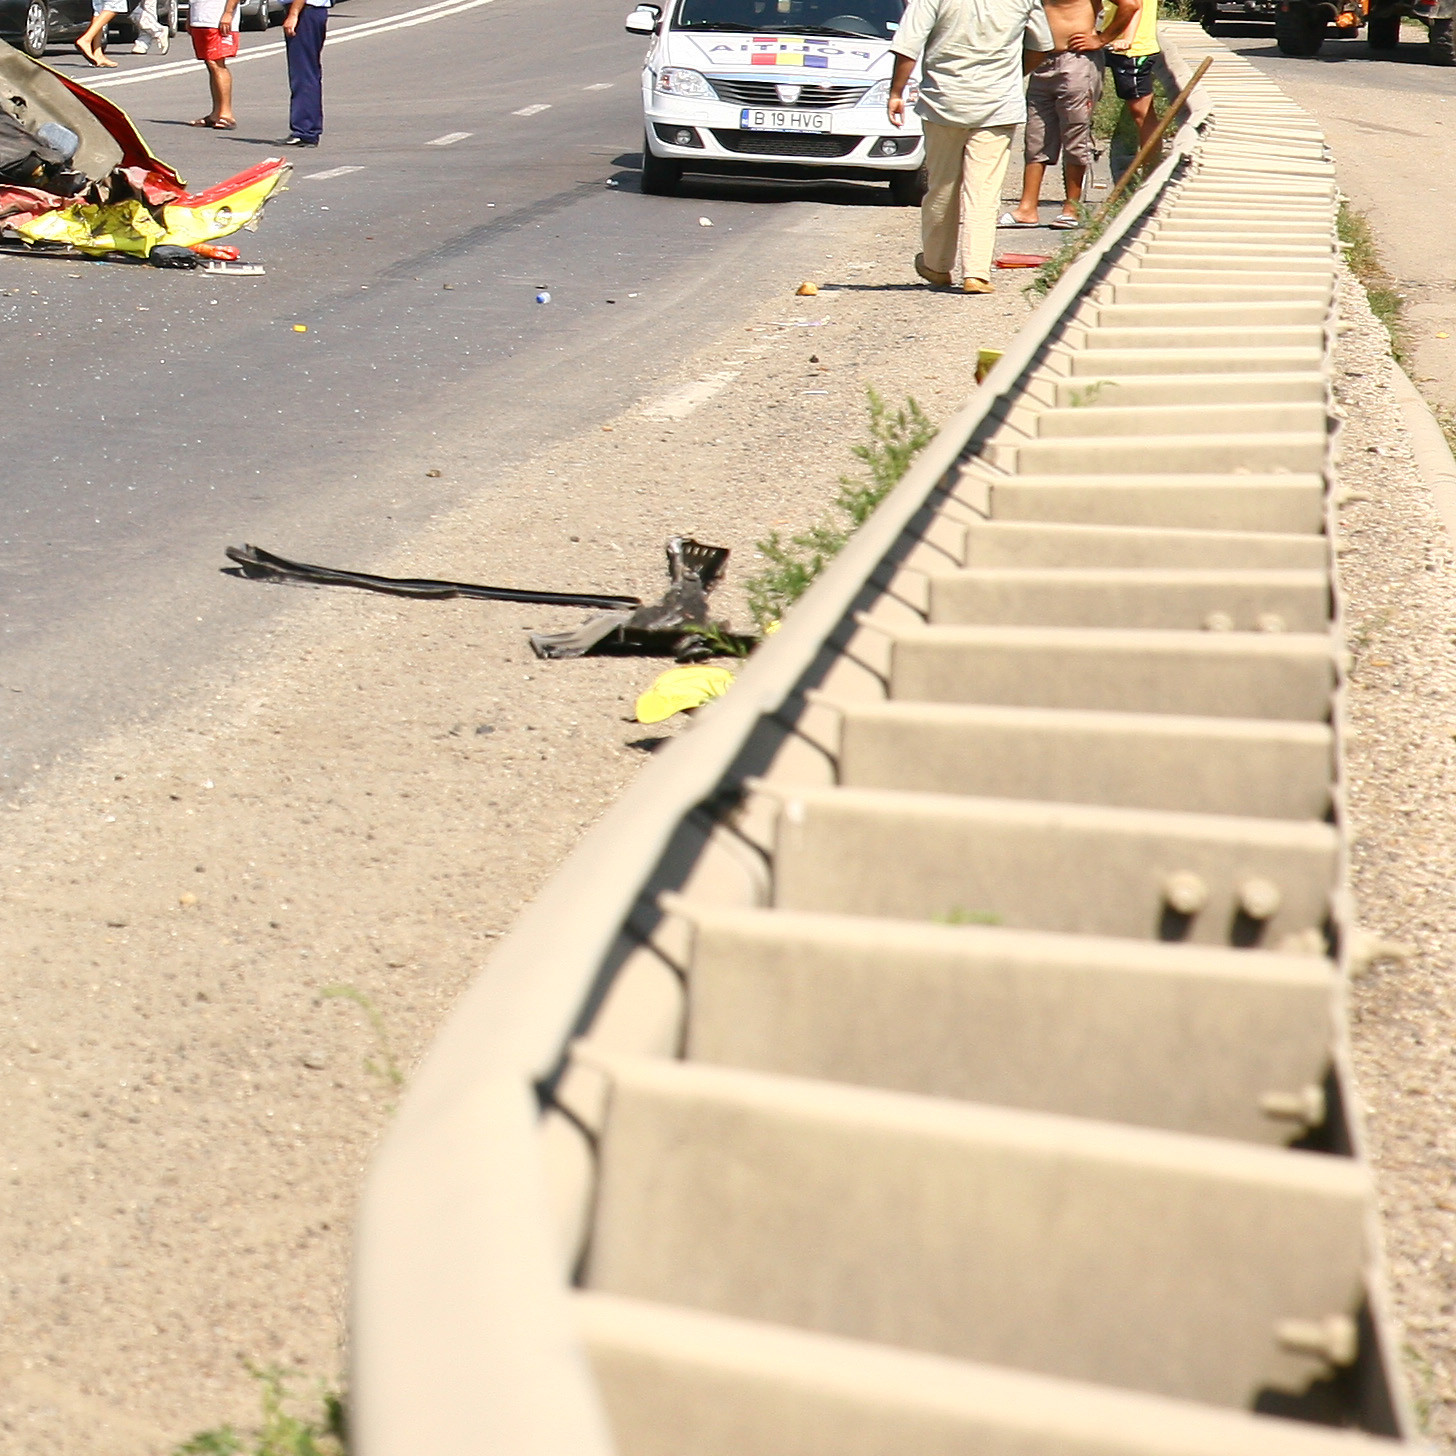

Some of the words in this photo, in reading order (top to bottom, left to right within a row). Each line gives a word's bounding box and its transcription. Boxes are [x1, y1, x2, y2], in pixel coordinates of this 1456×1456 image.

[754, 111, 765, 125] B
[771, 112, 785, 126] 19
[790, 113, 823, 128] HVG
